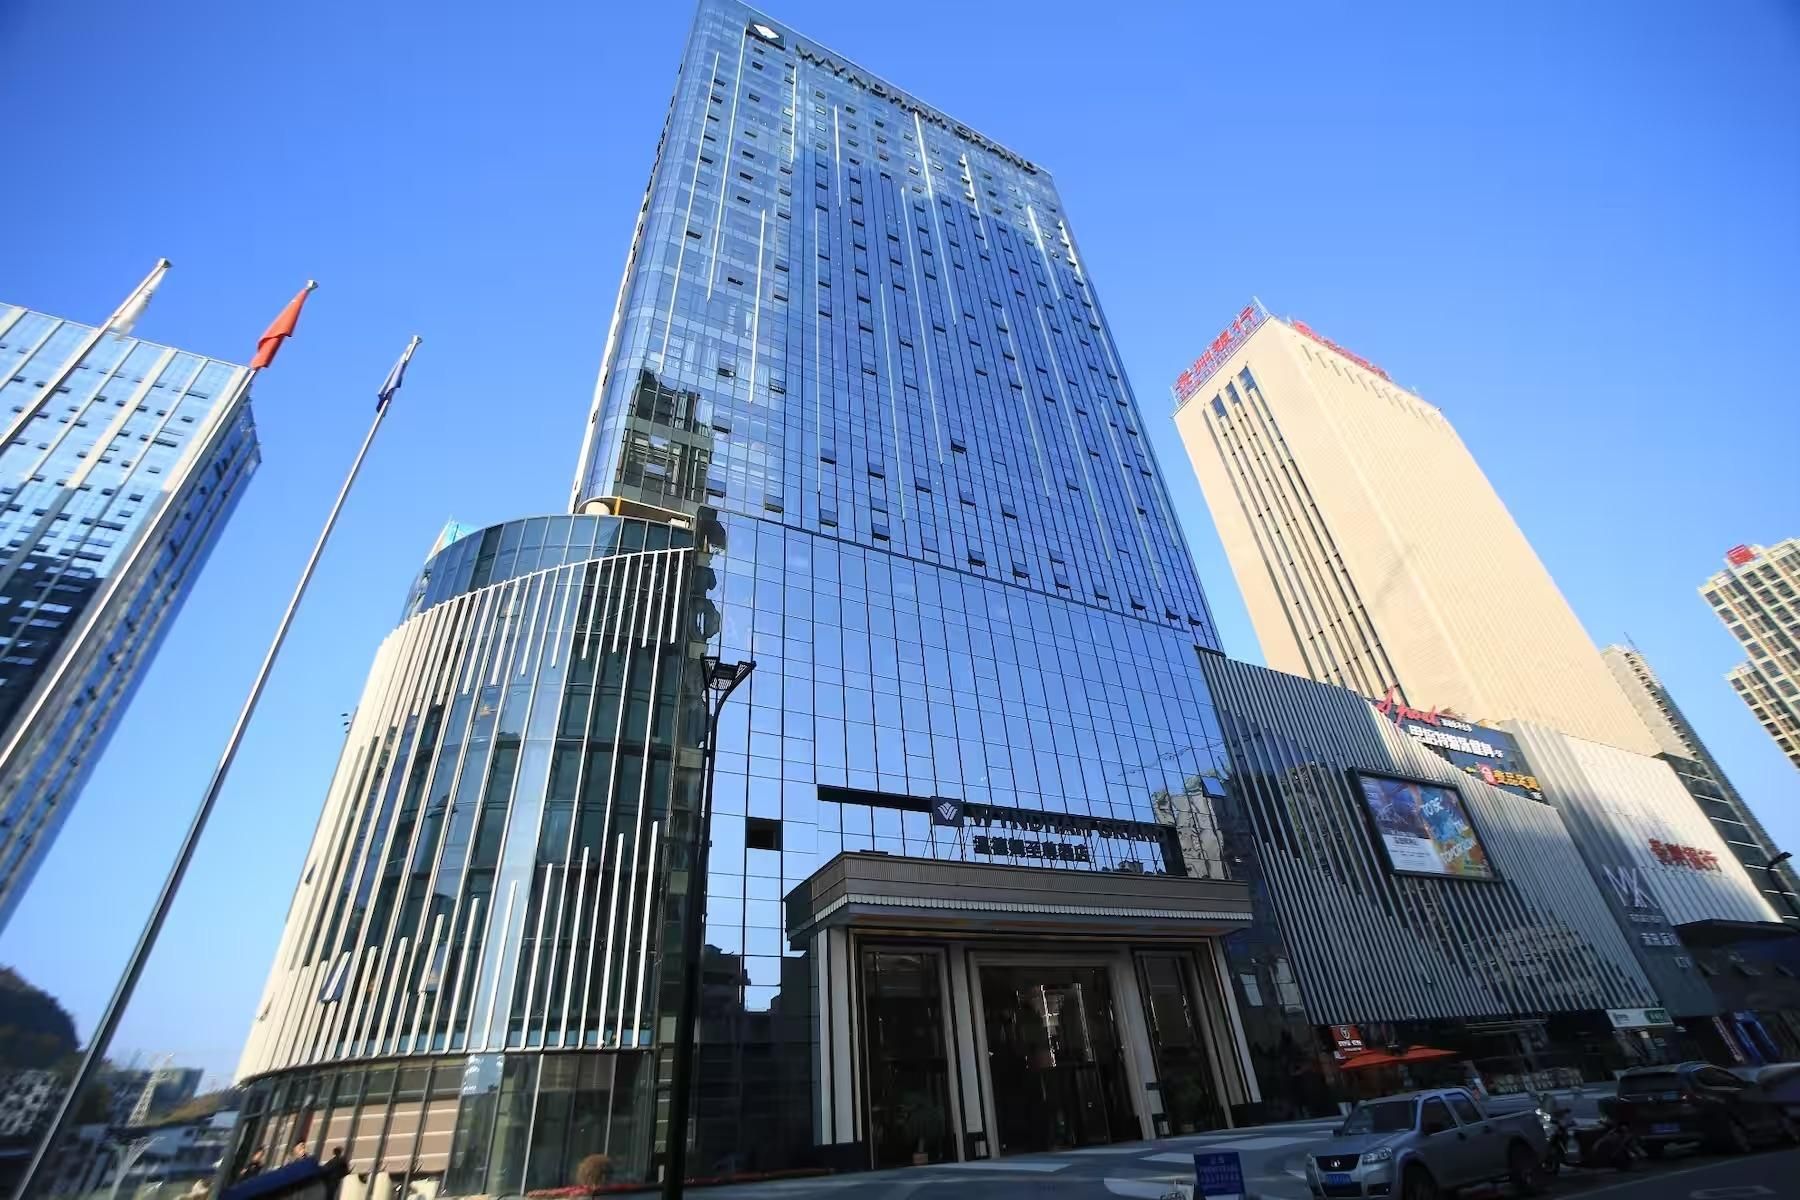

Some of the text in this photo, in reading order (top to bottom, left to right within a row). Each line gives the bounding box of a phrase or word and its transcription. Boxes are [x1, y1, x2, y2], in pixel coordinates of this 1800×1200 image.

[795, 43, 1039, 176] WYNDHAM GRAND
[971, 807, 1165, 843] WYNDHAM GRAND
